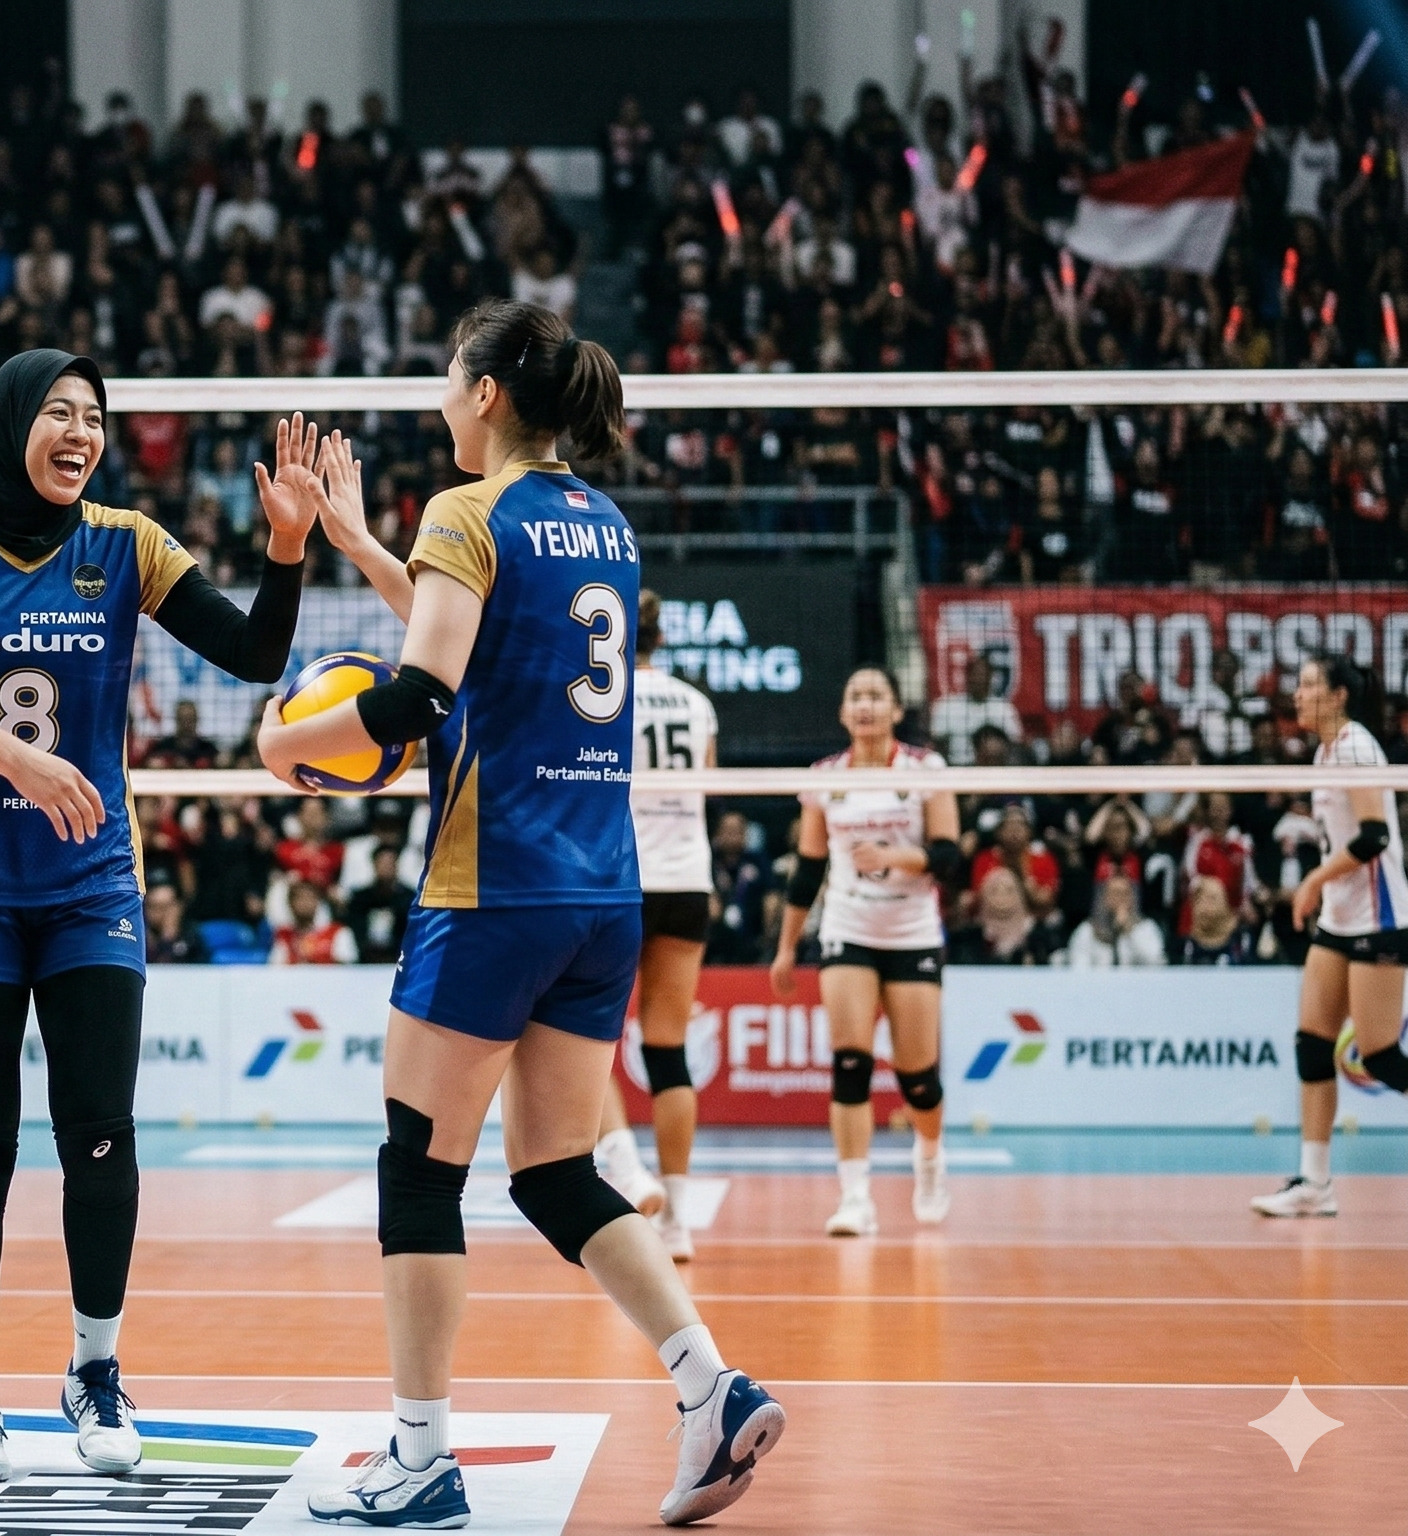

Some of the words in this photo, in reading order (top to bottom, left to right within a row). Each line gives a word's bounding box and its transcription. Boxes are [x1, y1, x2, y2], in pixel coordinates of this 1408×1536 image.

[521, 521, 600, 559] YEUM
[20, 611, 107, 625] PERTAMINA
[567, 582, 627, 723] 3
[576, 746, 619, 763] Jakarta
[643, 724, 692, 769] 15
[536, 765, 602, 782] Pertamina
[1065, 1038, 1280, 1069] PERTAMINA
